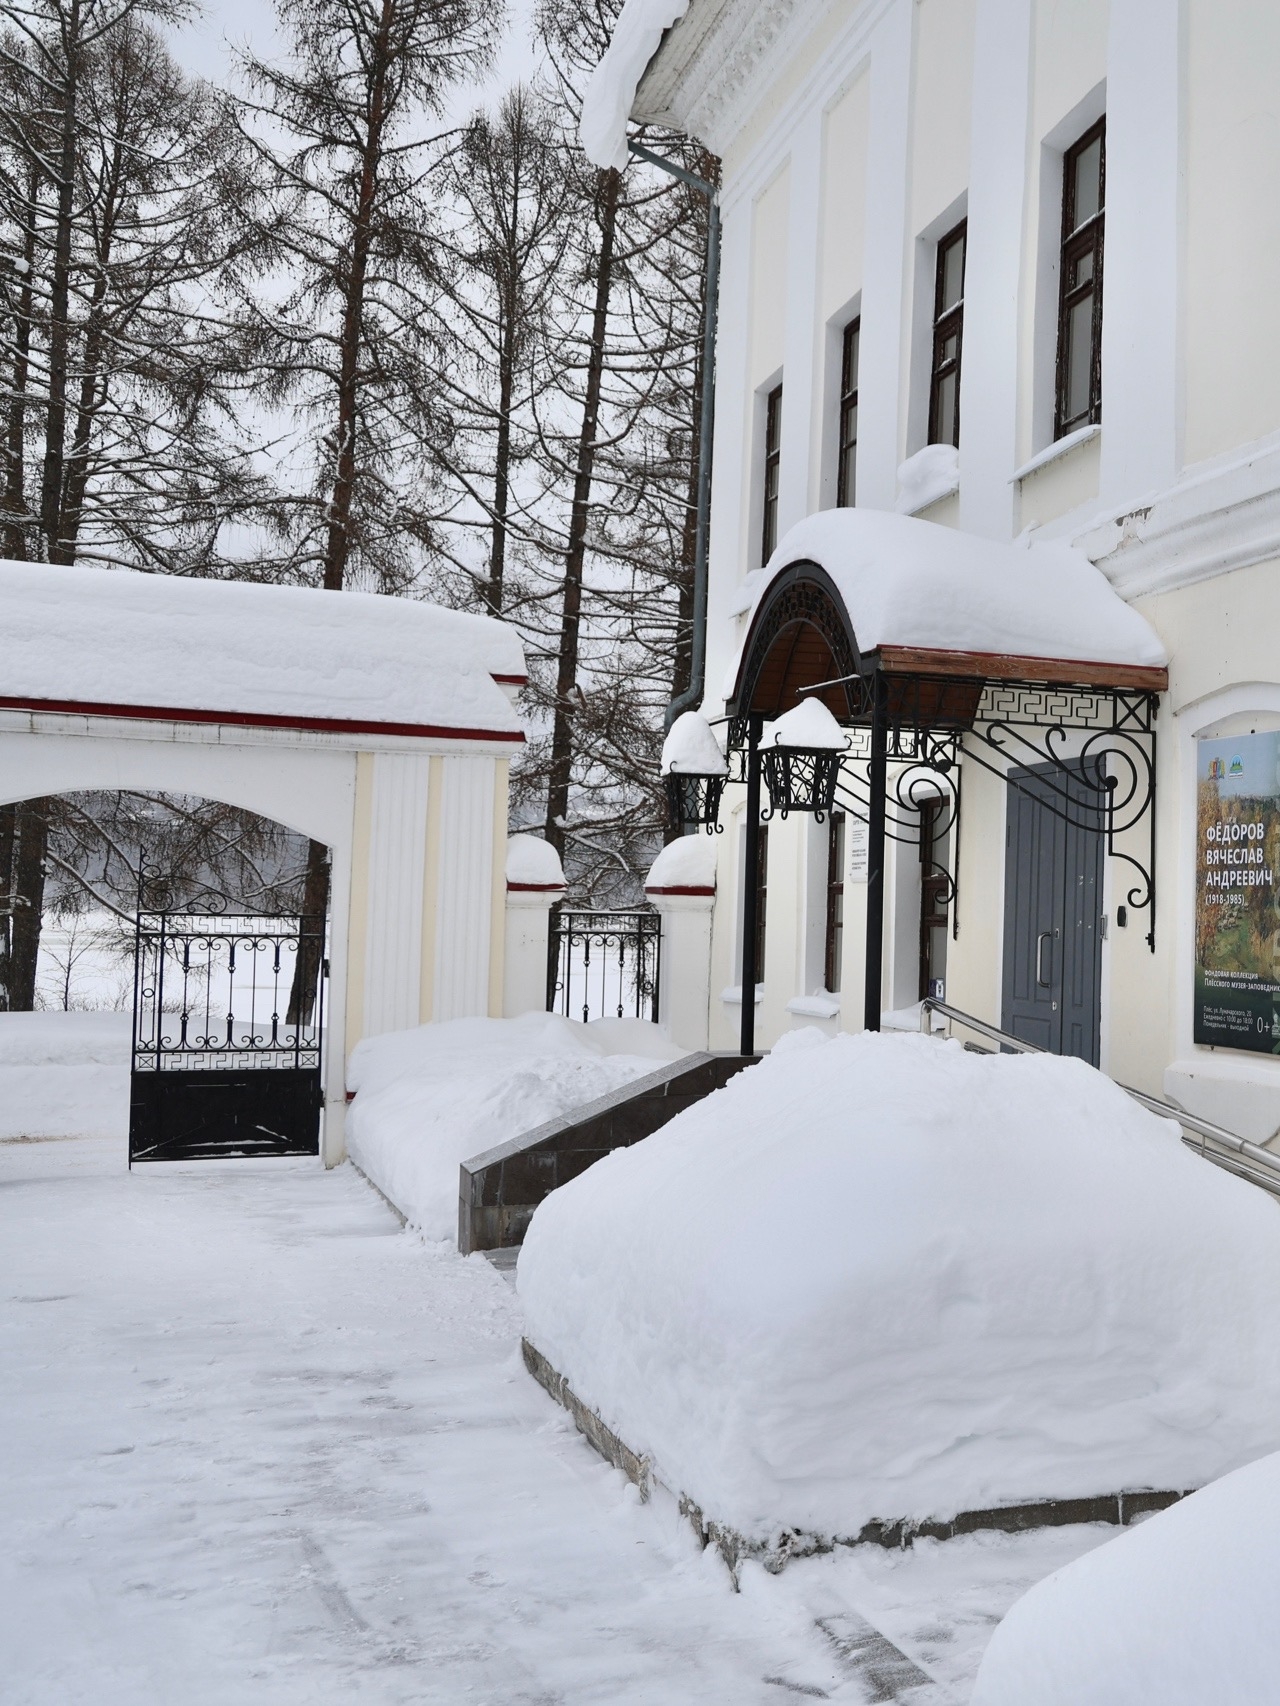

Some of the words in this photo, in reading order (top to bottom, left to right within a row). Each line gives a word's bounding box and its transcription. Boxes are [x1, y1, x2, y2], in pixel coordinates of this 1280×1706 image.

[1206, 822, 1264, 845] ФЁДОРОВ
[1206, 848, 1264, 865] ВЯЧЕСЛАВ
[1205, 869, 1273, 890] АНДРЕЕВИЧ
[1205, 893, 1245, 906] (1918-1985)
[1257, 1016, 1270, 1033] 0+
